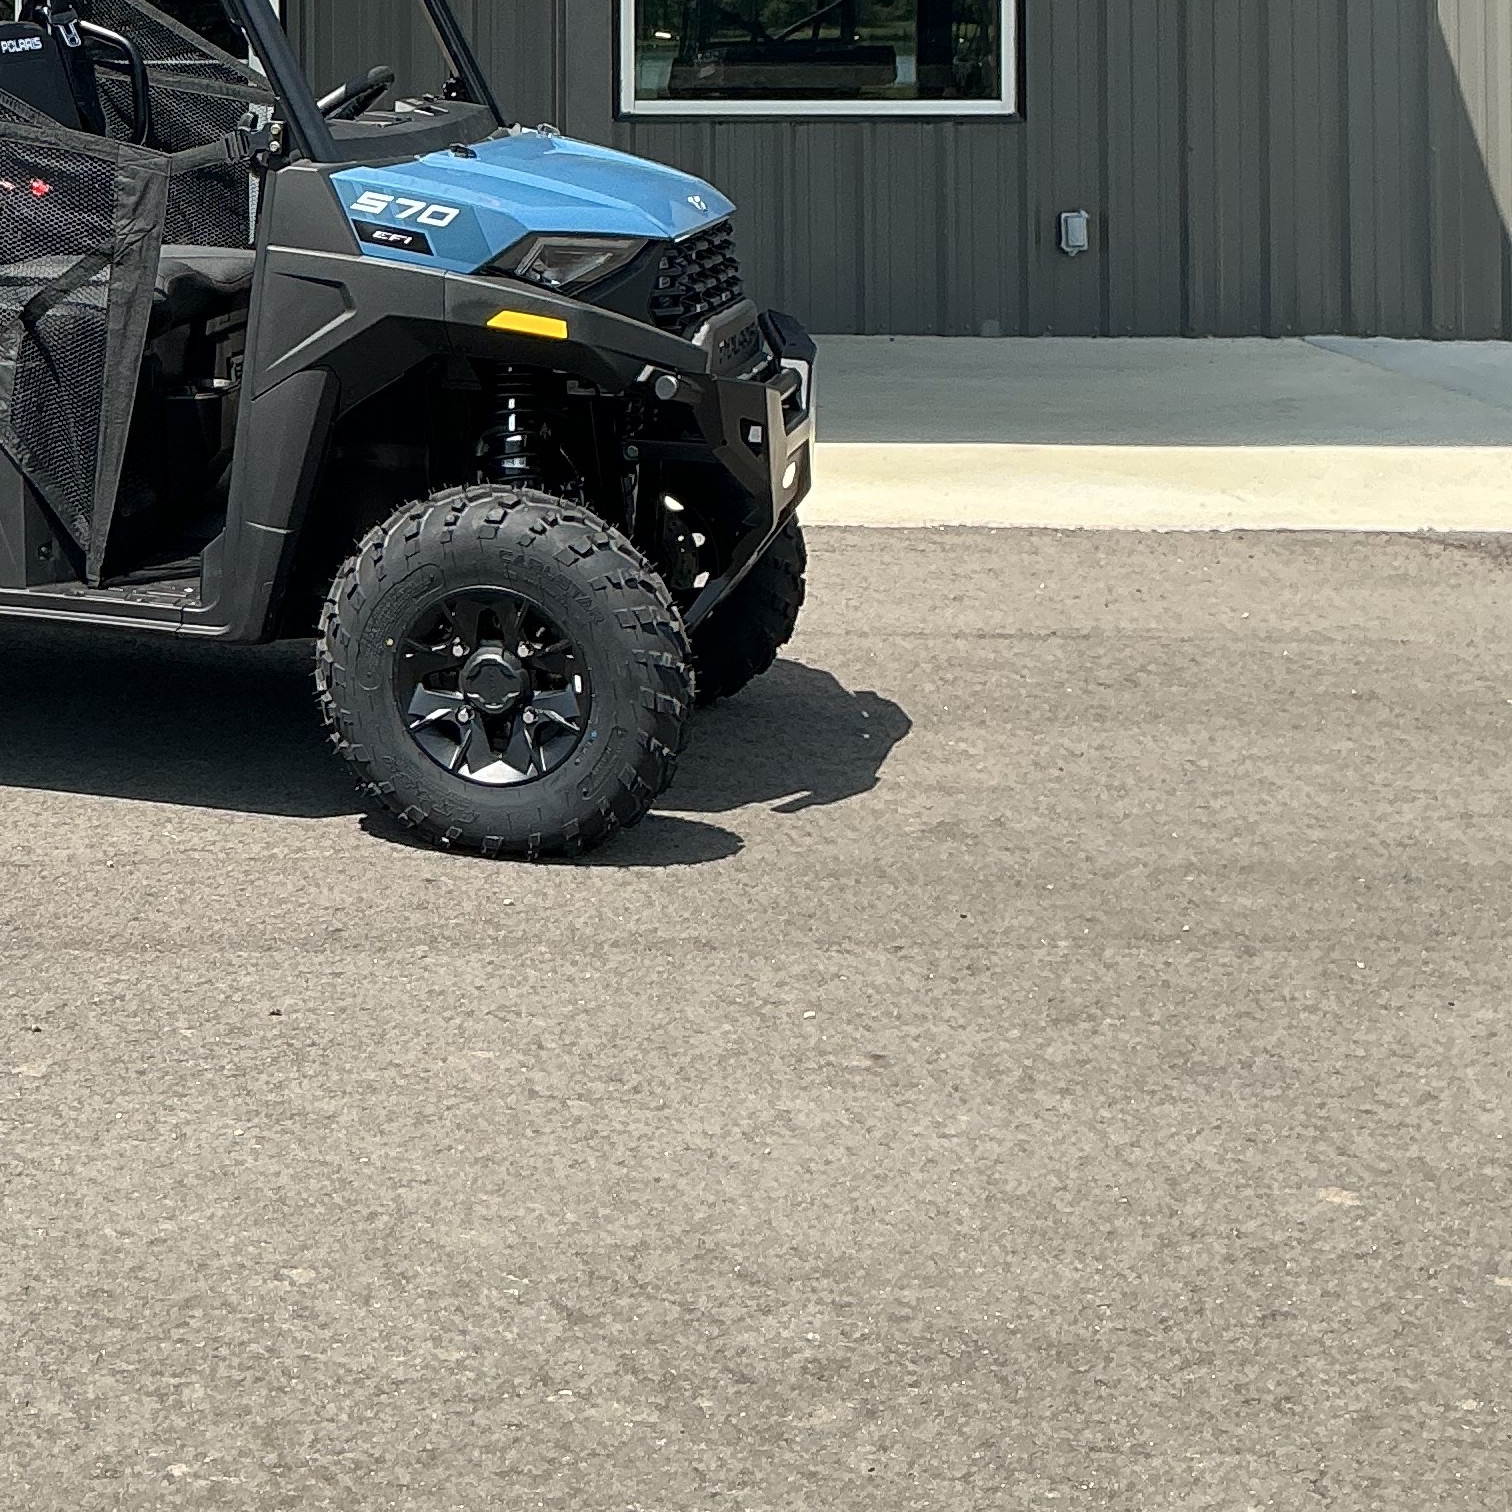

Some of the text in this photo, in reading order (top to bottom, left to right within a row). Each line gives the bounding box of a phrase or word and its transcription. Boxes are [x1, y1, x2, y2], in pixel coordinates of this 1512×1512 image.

[0, 36, 43, 54] POLARIS
[349, 190, 461, 228] 570
[372, 230, 414, 245] EFI
